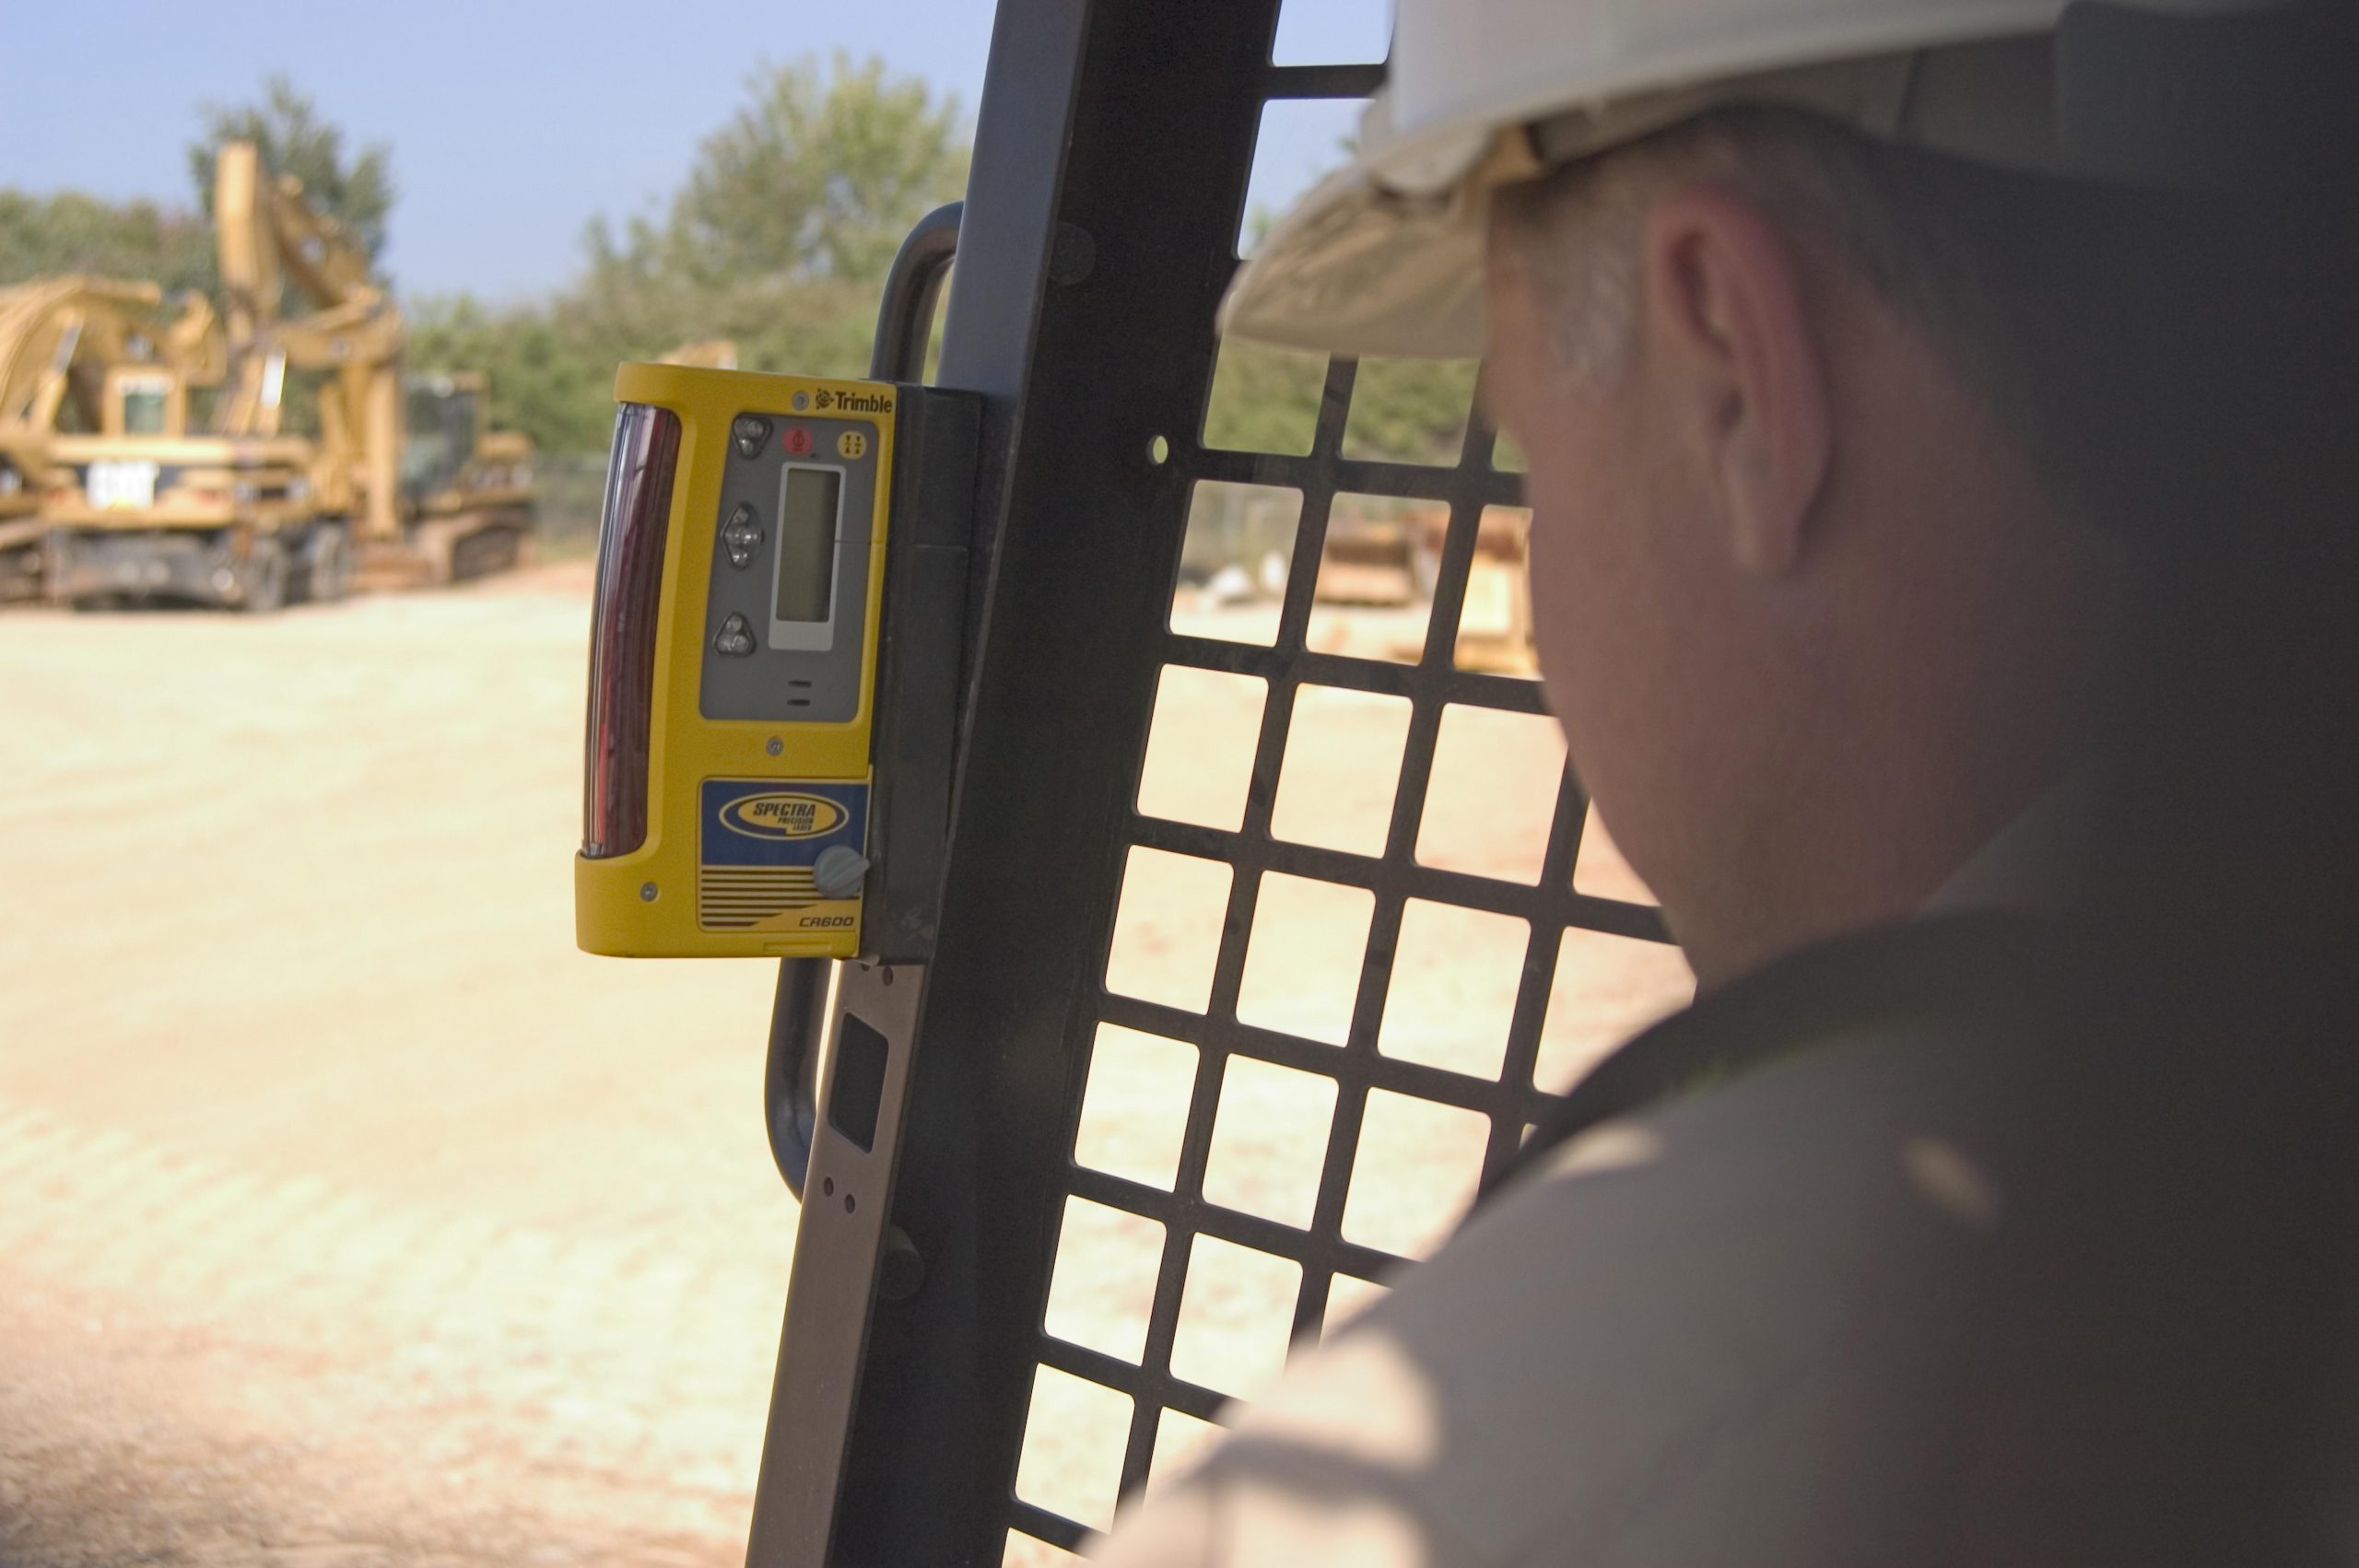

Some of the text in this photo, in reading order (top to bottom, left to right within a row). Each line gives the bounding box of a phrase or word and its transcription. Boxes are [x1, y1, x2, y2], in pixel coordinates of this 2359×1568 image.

[835, 391, 893, 413] Trimble
[753, 802, 816, 817] SPECTRA
[799, 917, 855, 927] CA600
